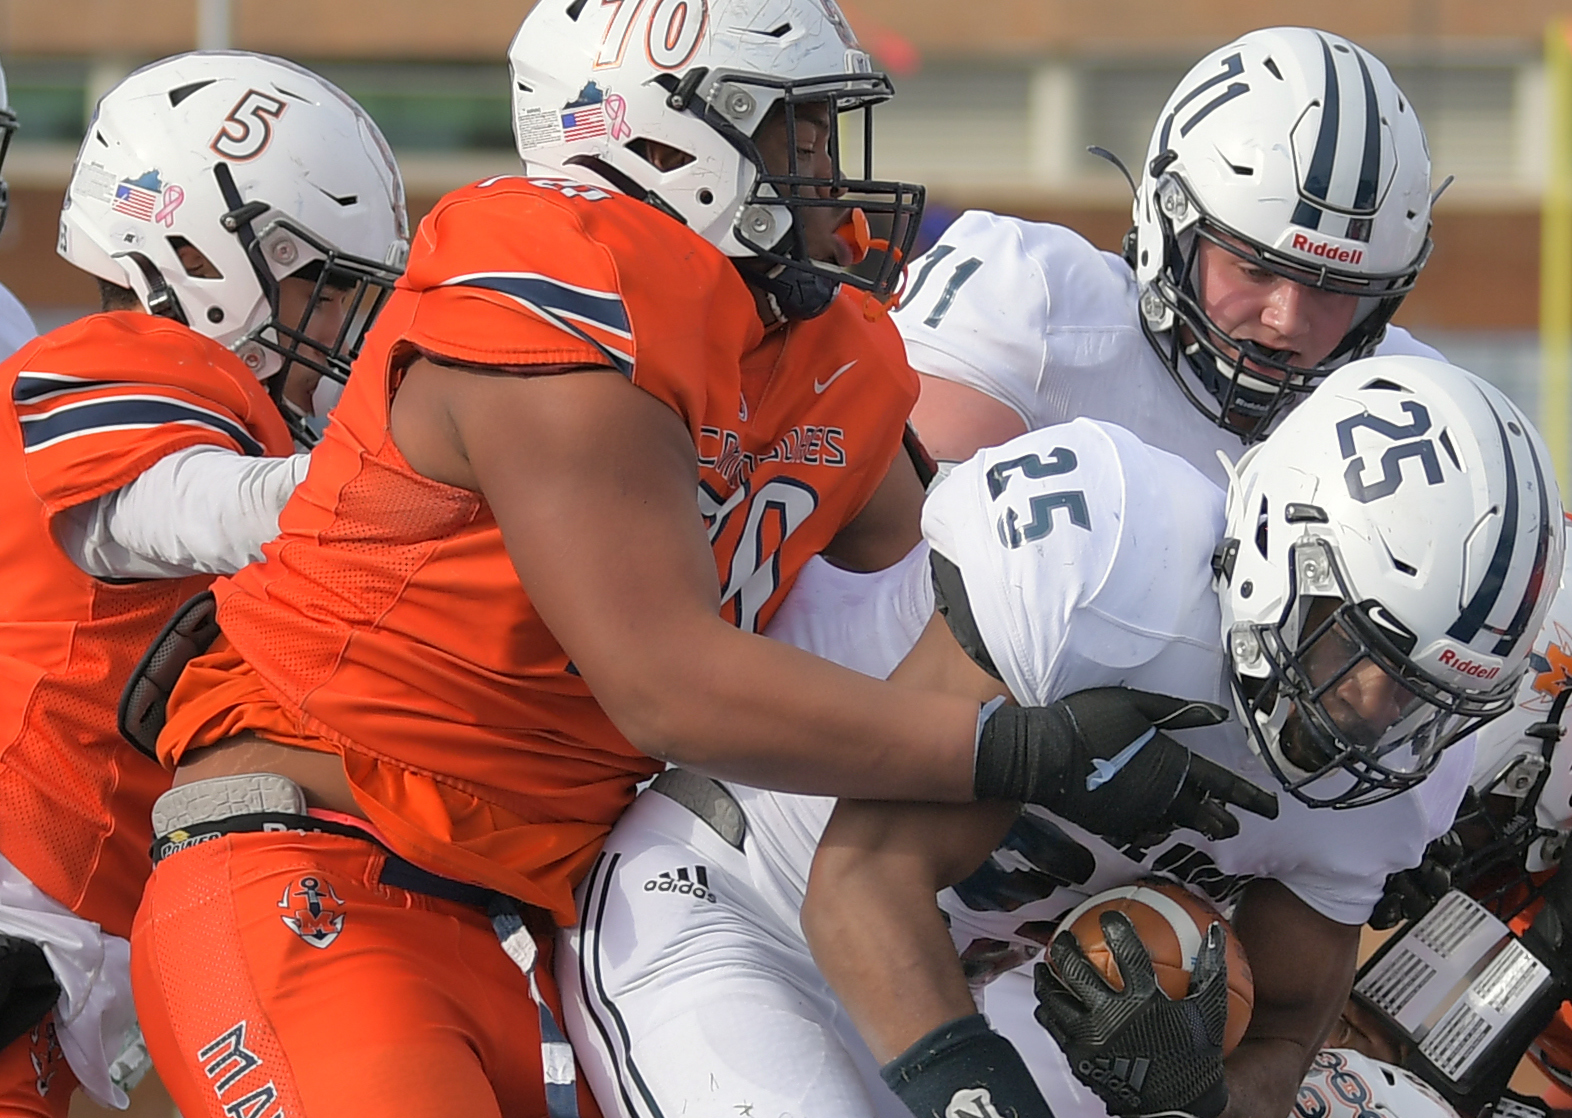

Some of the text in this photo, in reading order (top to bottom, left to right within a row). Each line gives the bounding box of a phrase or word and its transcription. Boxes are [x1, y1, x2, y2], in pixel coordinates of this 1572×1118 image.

[592, 0, 710, 72] 70
[209, 88, 289, 163] 5
[1172, 52, 1251, 139] 71
[1292, 233, 1363, 265] Riddell
[1335, 400, 1445, 505] 25
[986, 447, 1093, 550] 25
[1438, 648, 1501, 680] Riddell
[643, 878, 717, 904] adidas
[1079, 1060, 1141, 1108] adidas
